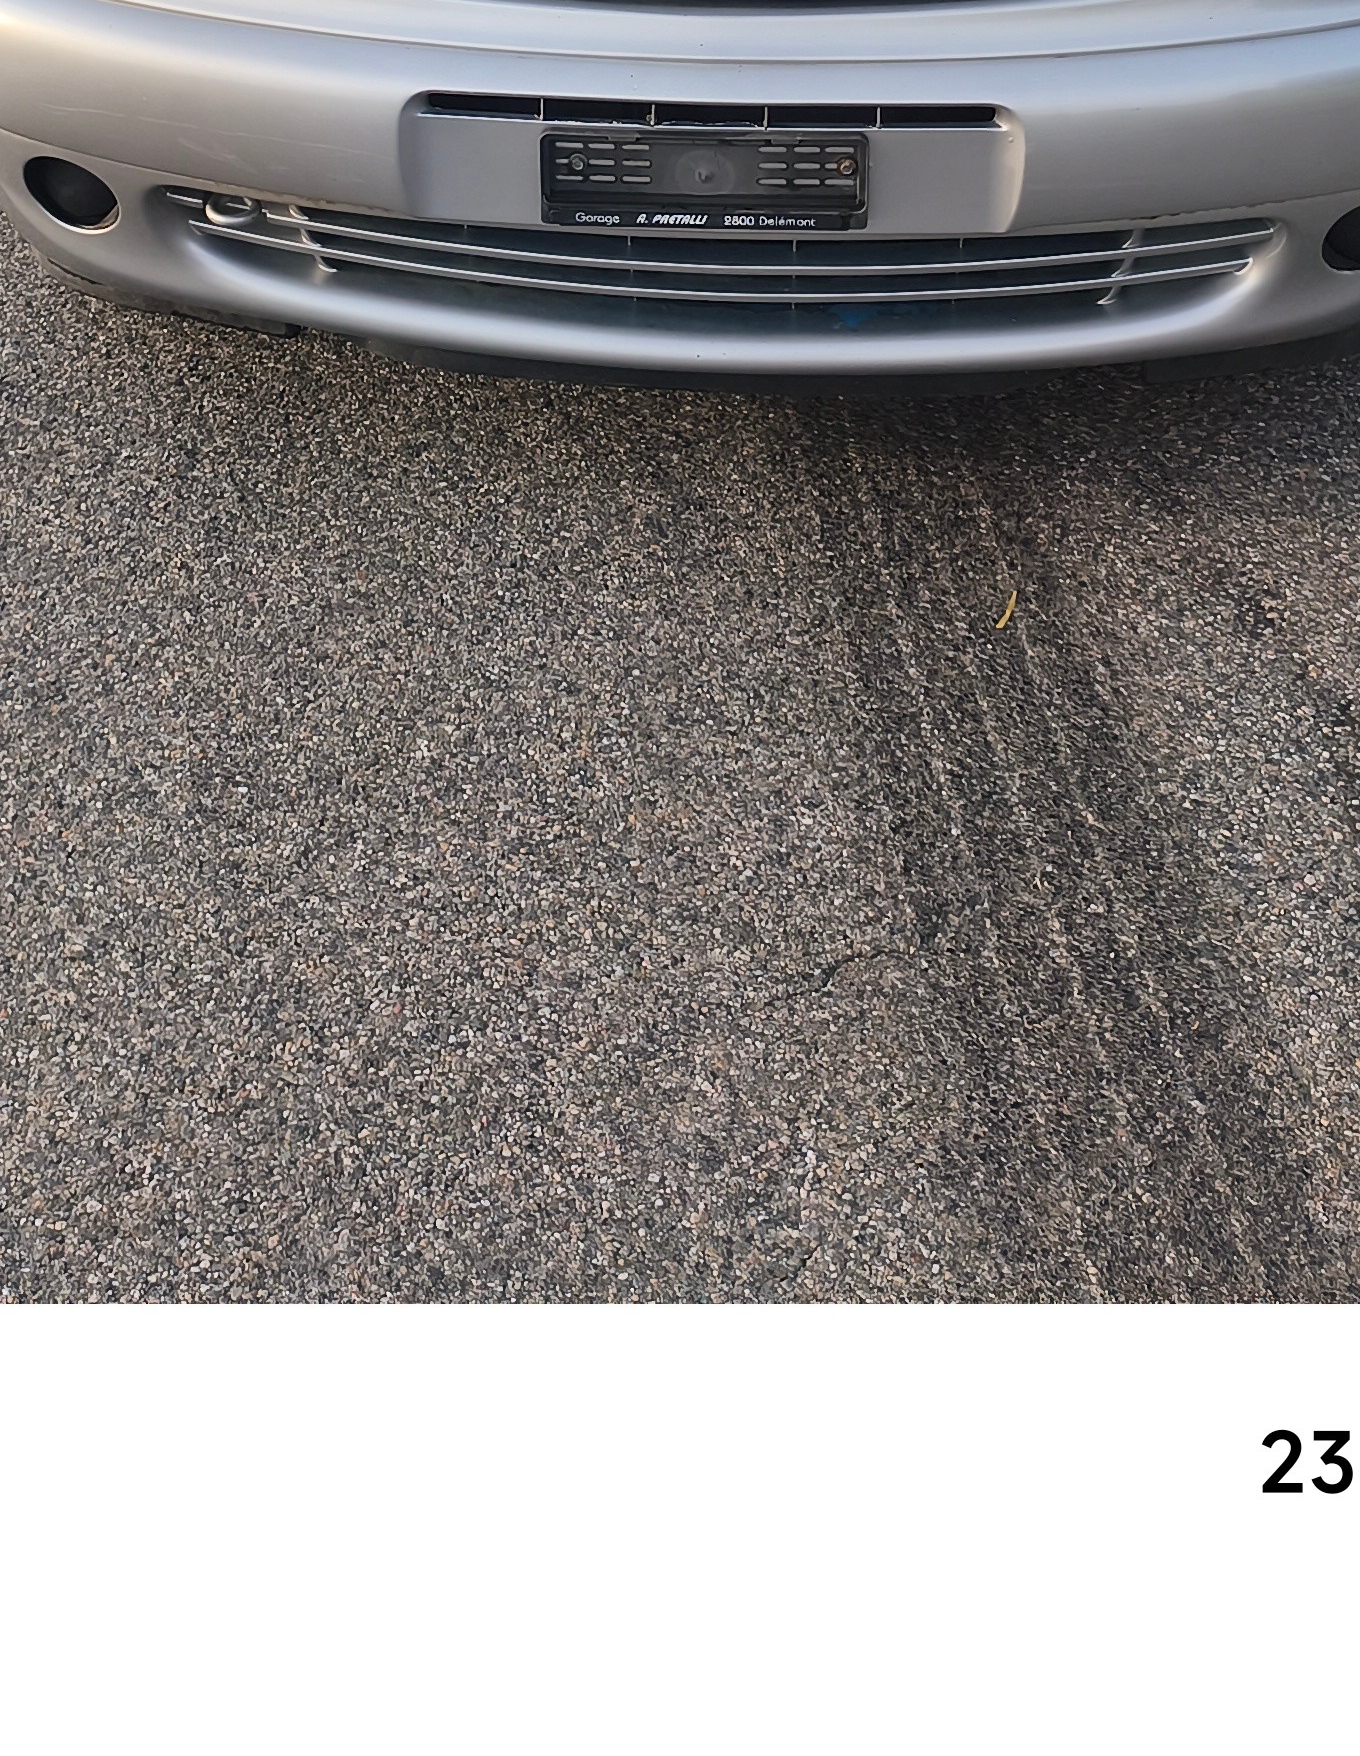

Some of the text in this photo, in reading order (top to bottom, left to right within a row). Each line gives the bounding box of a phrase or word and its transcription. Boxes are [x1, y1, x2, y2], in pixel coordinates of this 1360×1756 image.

[575, 211, 620, 226] Garage
[635, 213, 649, 224] A.
[723, 215, 755, 226] 2800
[758, 215, 817, 227] Delémont
